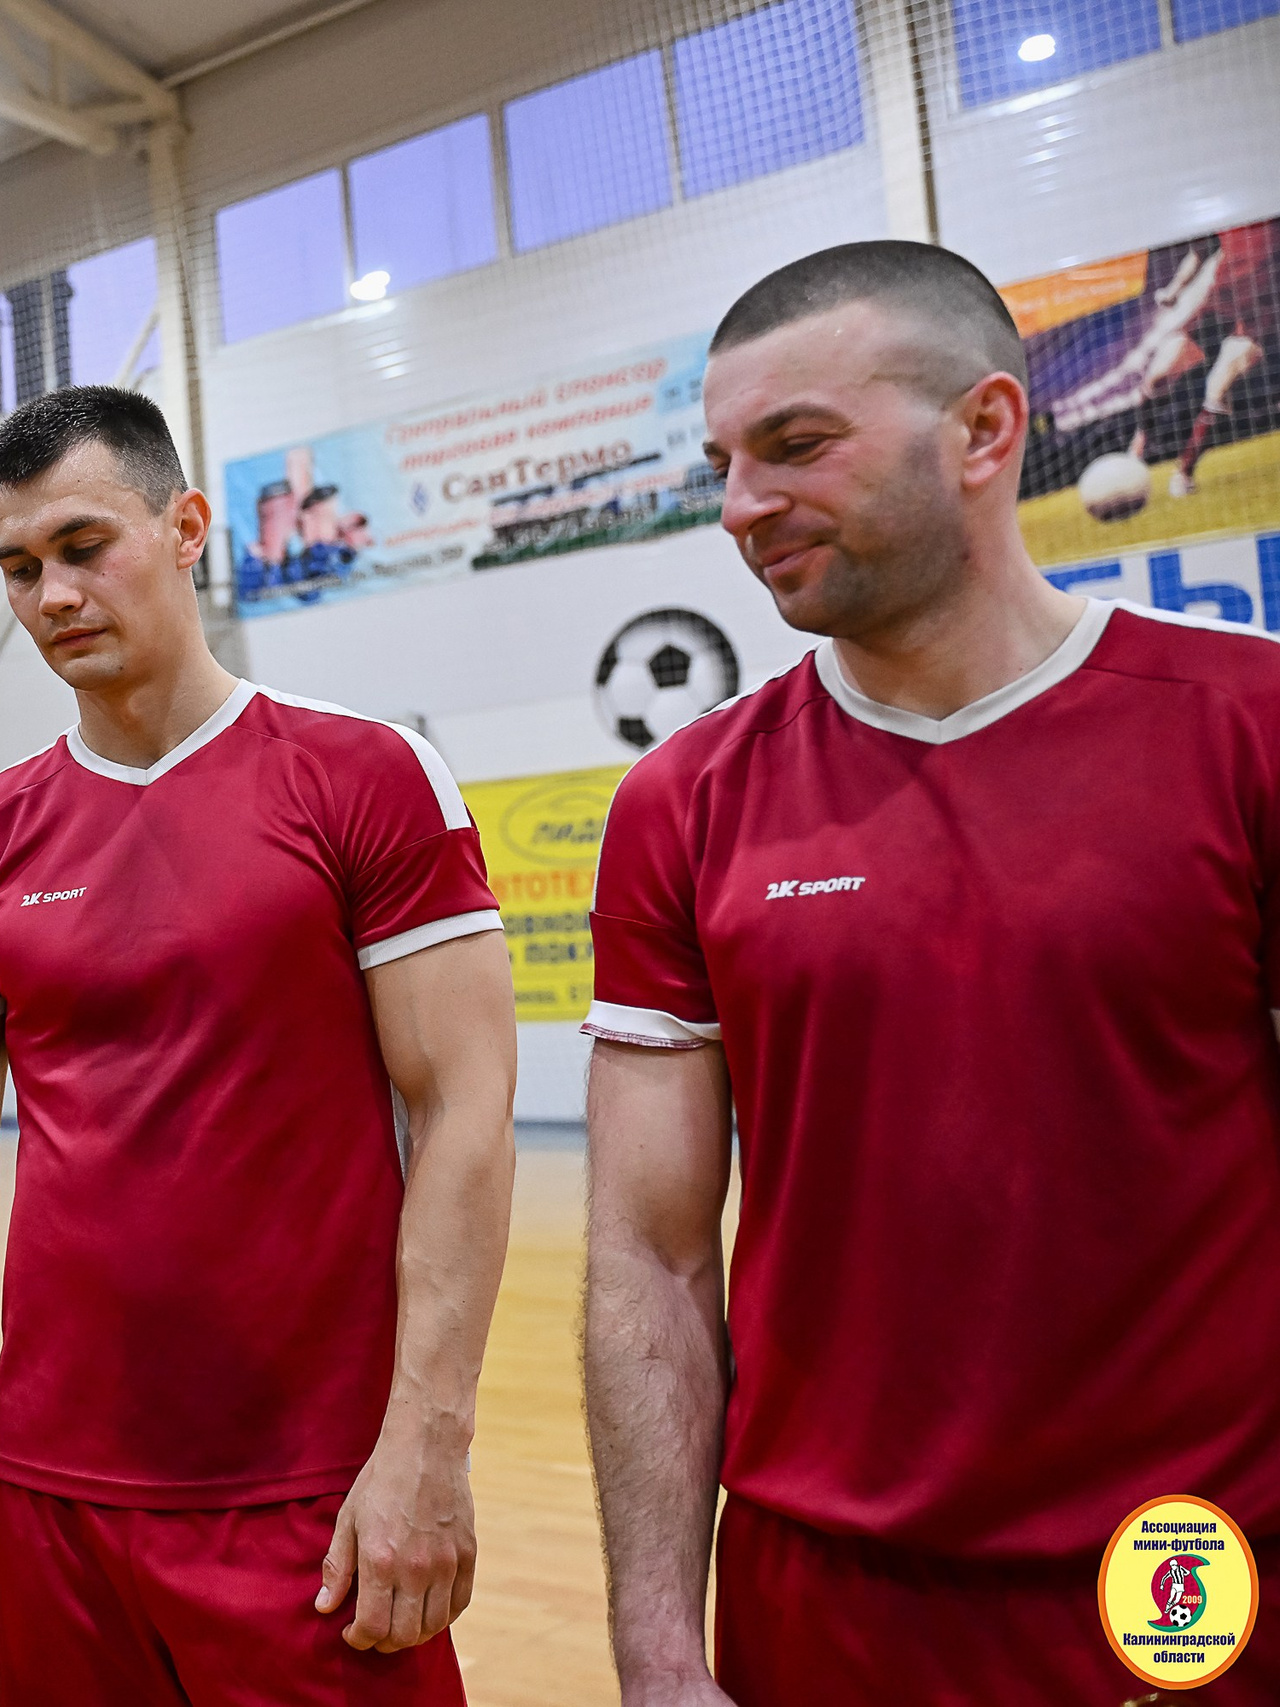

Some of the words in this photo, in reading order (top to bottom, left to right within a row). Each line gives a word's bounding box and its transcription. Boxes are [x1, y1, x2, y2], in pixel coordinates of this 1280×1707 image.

[441, 441, 633, 504] СанТермо
[20, 891, 44, 907] 2K
[42, 886, 88, 903] SPORT
[764, 880, 800, 900] 2K
[797, 876, 866, 896] SPORT
